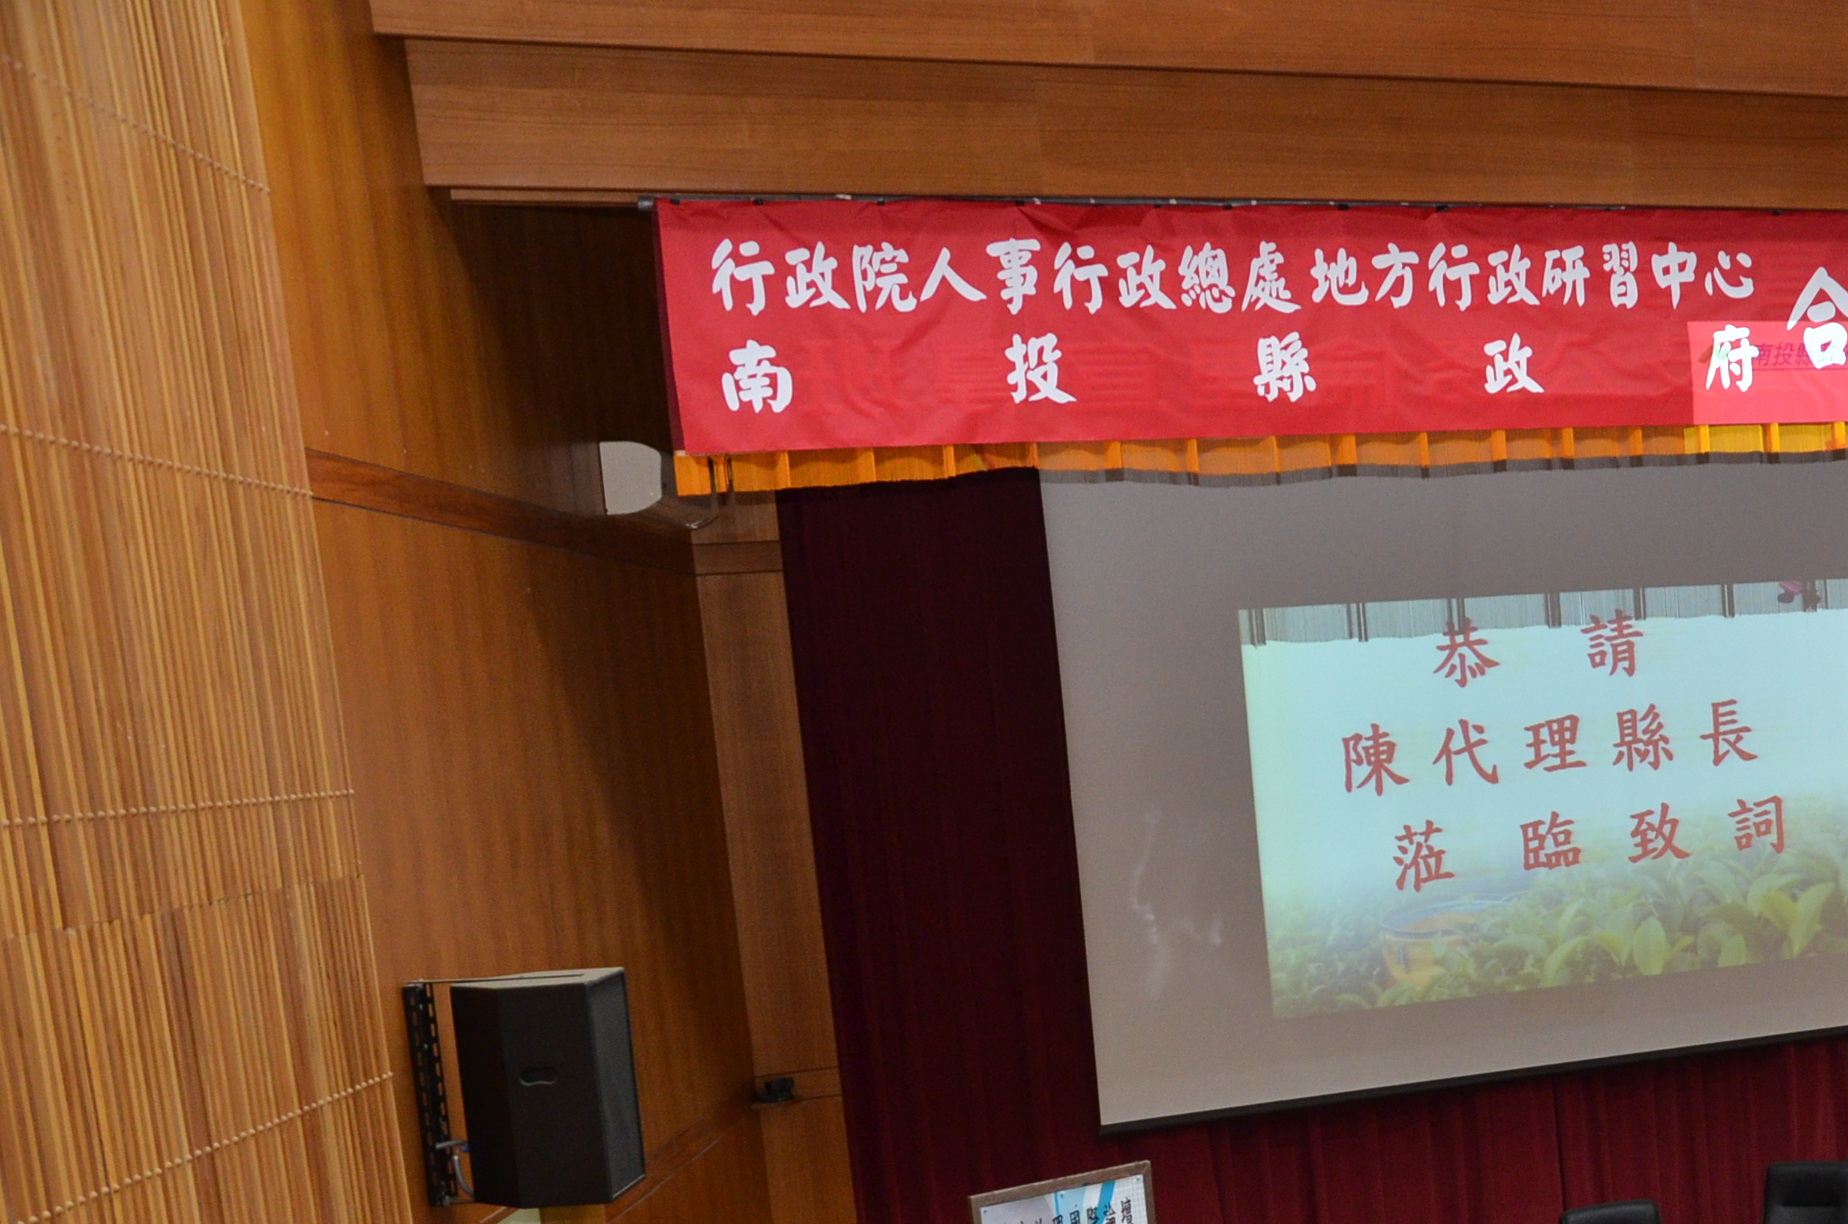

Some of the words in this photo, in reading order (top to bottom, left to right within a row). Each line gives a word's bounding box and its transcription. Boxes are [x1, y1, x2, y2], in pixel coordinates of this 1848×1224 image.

[711, 238, 1754, 316] 行政院人事行政總處地方行政研習中心
[722, 325, 1759, 413] 南投縣政府
[1434, 608, 1644, 688] 恭請
[1342, 698, 1758, 796] 陳代理縣長
[1393, 795, 1786, 892] 蒞臨致詞
